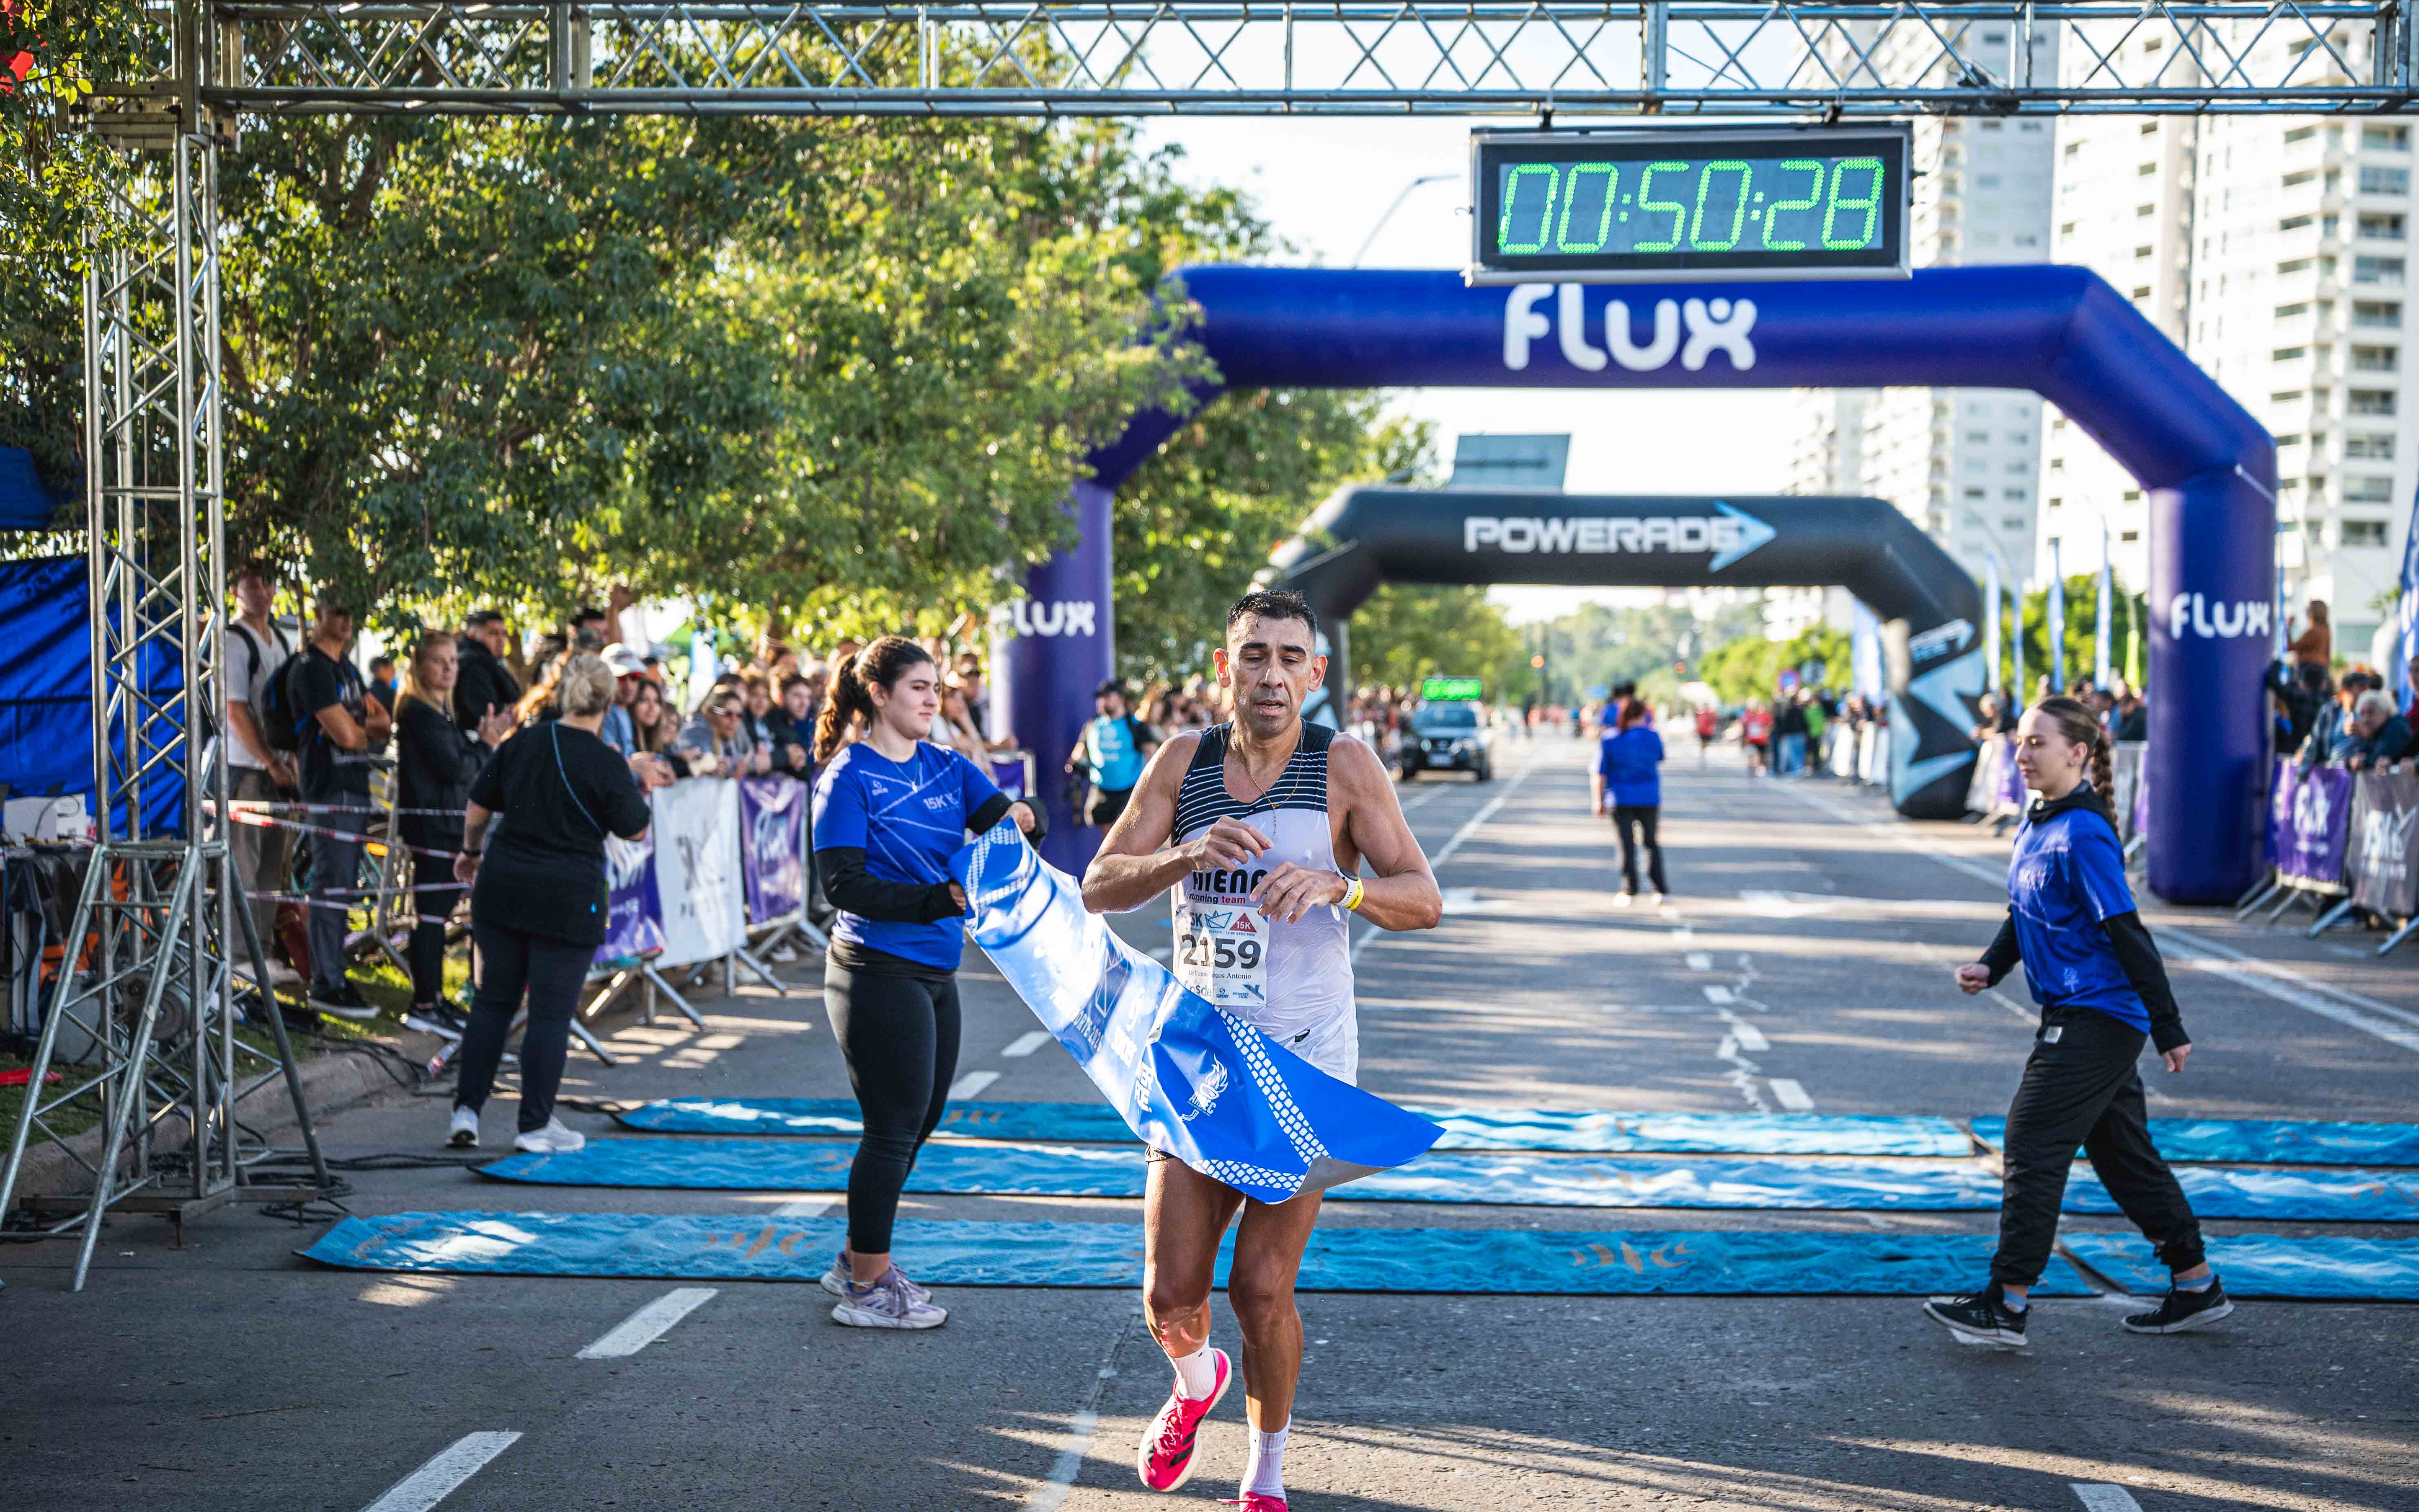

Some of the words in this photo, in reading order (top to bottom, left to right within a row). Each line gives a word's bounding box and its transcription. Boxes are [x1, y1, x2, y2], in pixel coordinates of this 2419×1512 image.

[1497, 159, 1884, 255] 00:50:28
[1189, 893, 1218, 904] running
[1191, 911, 1203, 928] 5K
[1182, 934, 1261, 969] 2159
